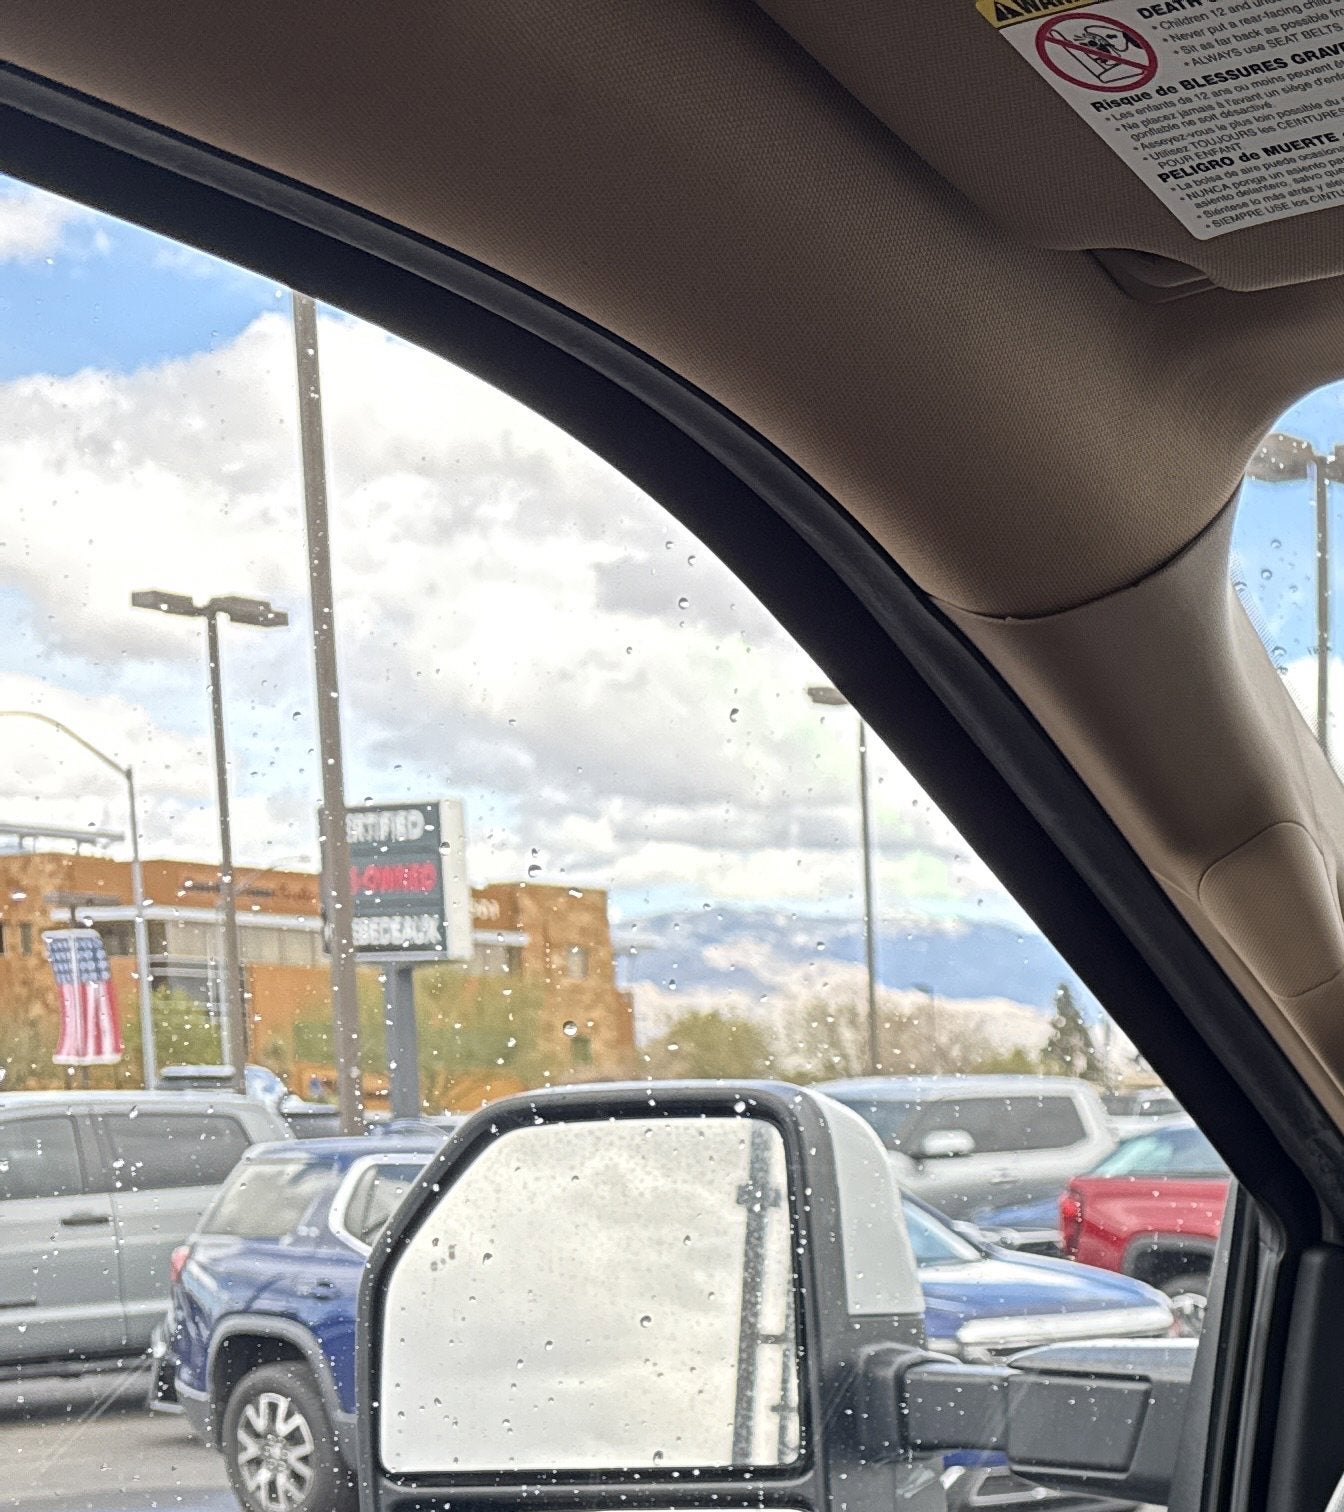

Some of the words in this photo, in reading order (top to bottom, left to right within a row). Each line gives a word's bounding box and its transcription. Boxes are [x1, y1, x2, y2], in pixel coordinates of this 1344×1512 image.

[1156, 10, 1211, 30] Children
[1208, 7, 1228, 17] 12
[1225, 2, 1252, 13] and
[1167, 26, 1207, 43] Never
[1204, 22, 1230, 35] put
[1226, 20, 1238, 28] a
[1236, 3, 1304, 27] rear-facing
[1188, 47, 1244, 67] ALWAYS
[1242, 43, 1267, 54] use
[1264, 32, 1302, 48] SEAT
[1299, 22, 1344, 39] BELTS
[1089, 89, 1155, 113] Risque
[1151, 82, 1179, 97] de
[1178, 56, 1290, 92] BLESSURES
[1147, 144, 1191, 160] Utilisez
[1187, 127, 1259, 150] TOUJOURS
[1256, 124, 1277, 134] les
[1155, 155, 1238, 183] PELIGRO
[1234, 149, 1262, 163] de
[1260, 130, 1340, 157] MUERTE
